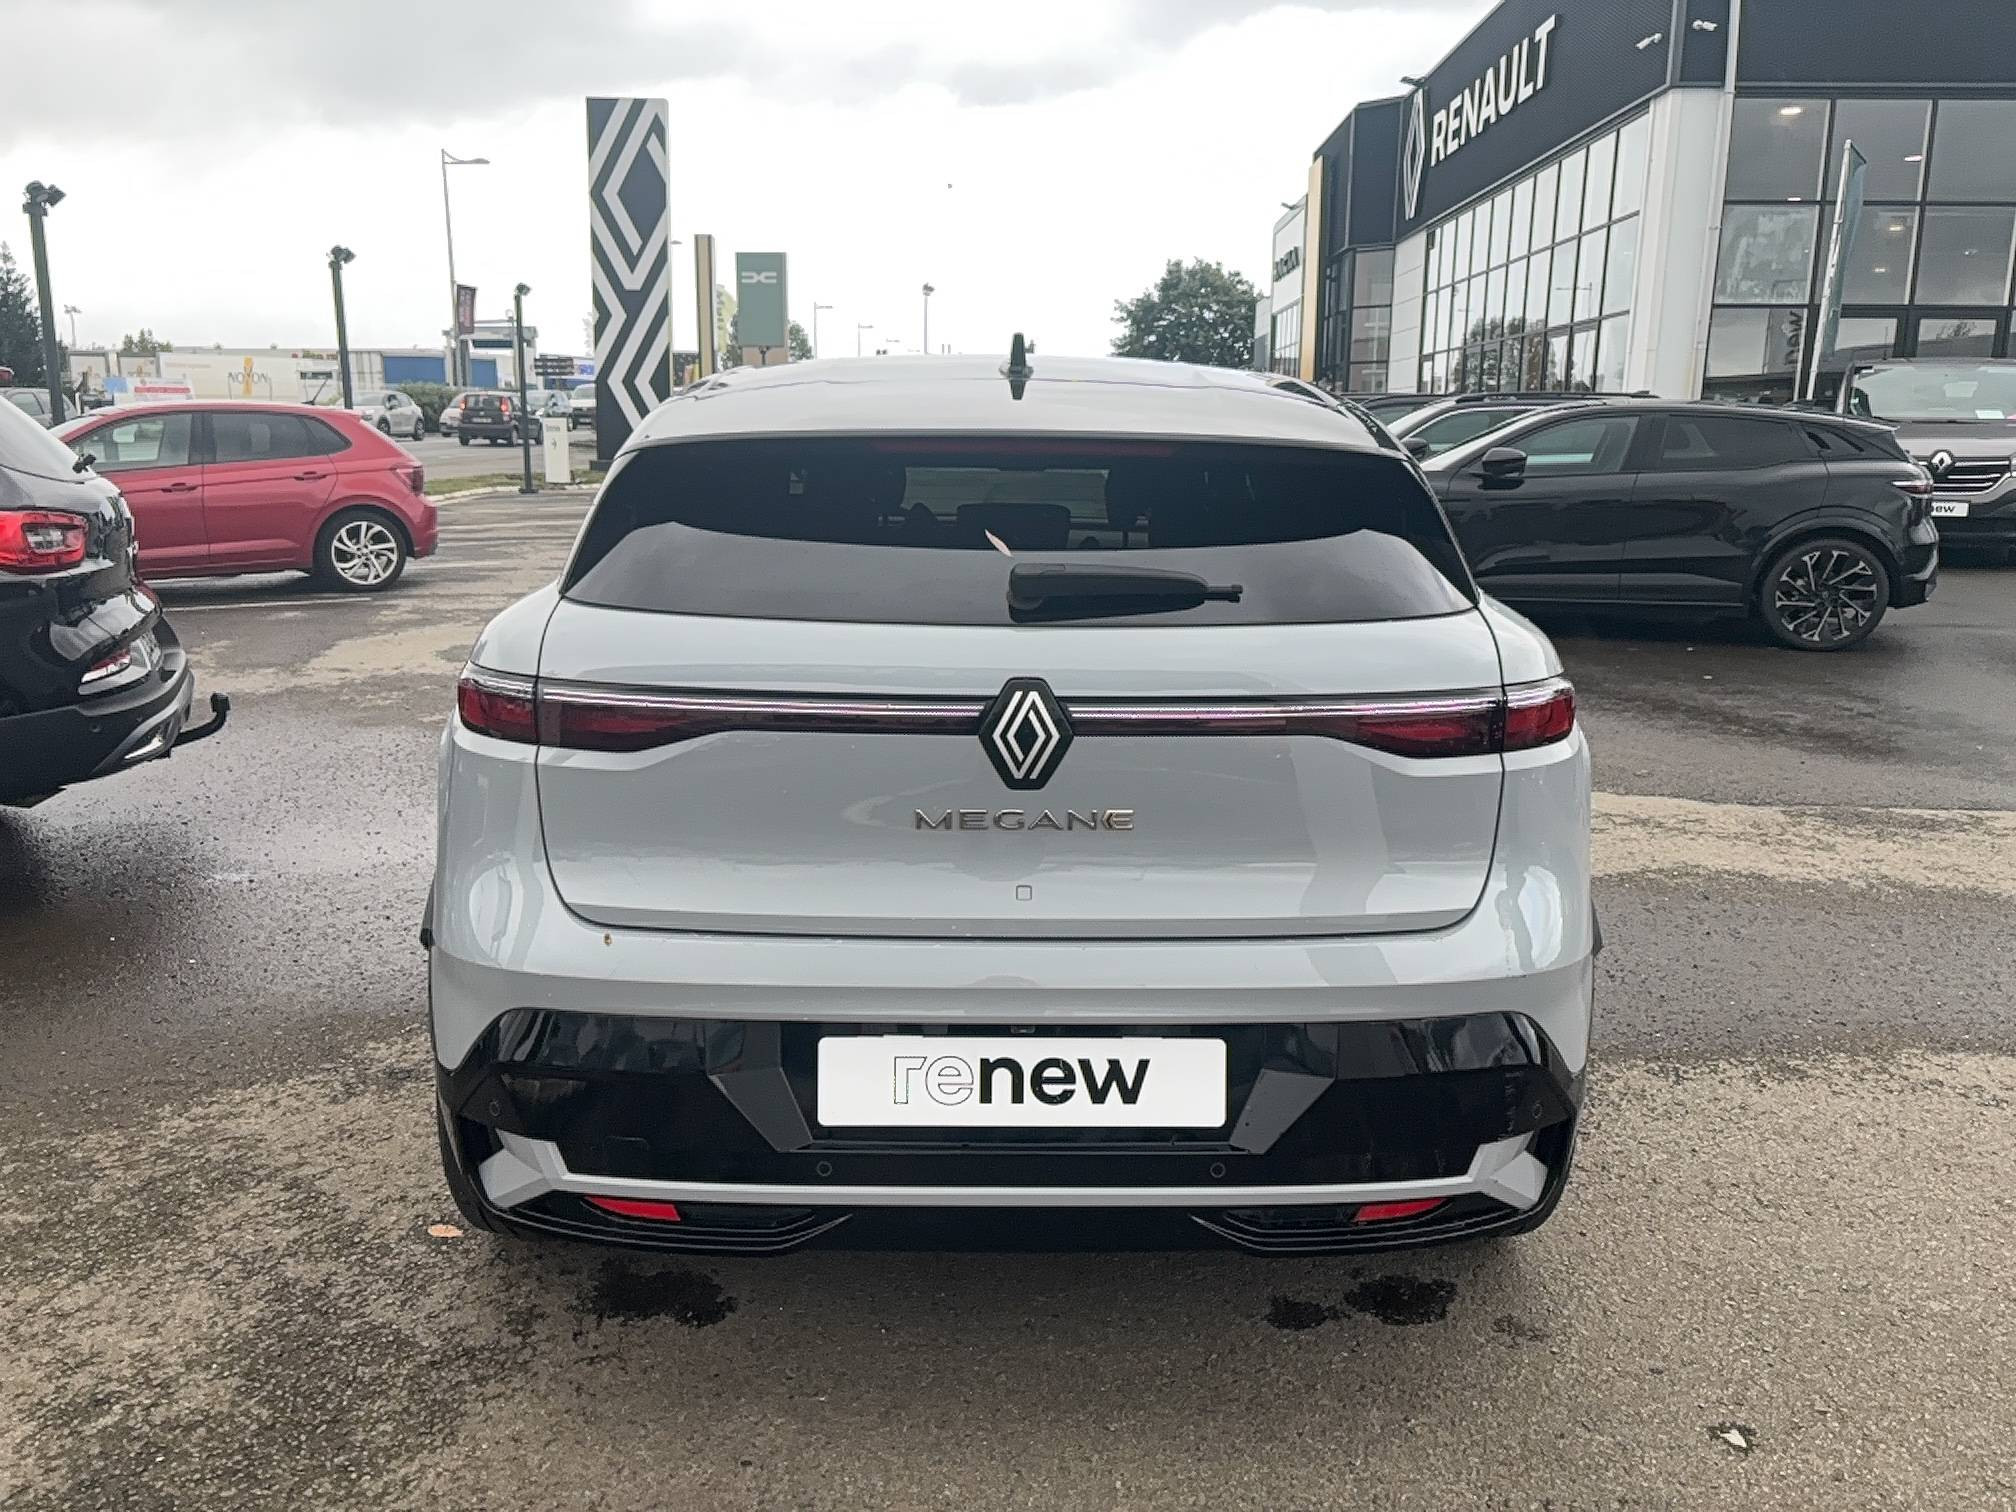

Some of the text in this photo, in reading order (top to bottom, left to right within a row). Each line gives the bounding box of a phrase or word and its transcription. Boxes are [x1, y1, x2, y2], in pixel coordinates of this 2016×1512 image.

[1430, 13, 1556, 167] RENAULT
[914, 808, 1135, 831] MEGANE
[894, 1055, 1151, 1106] renew
